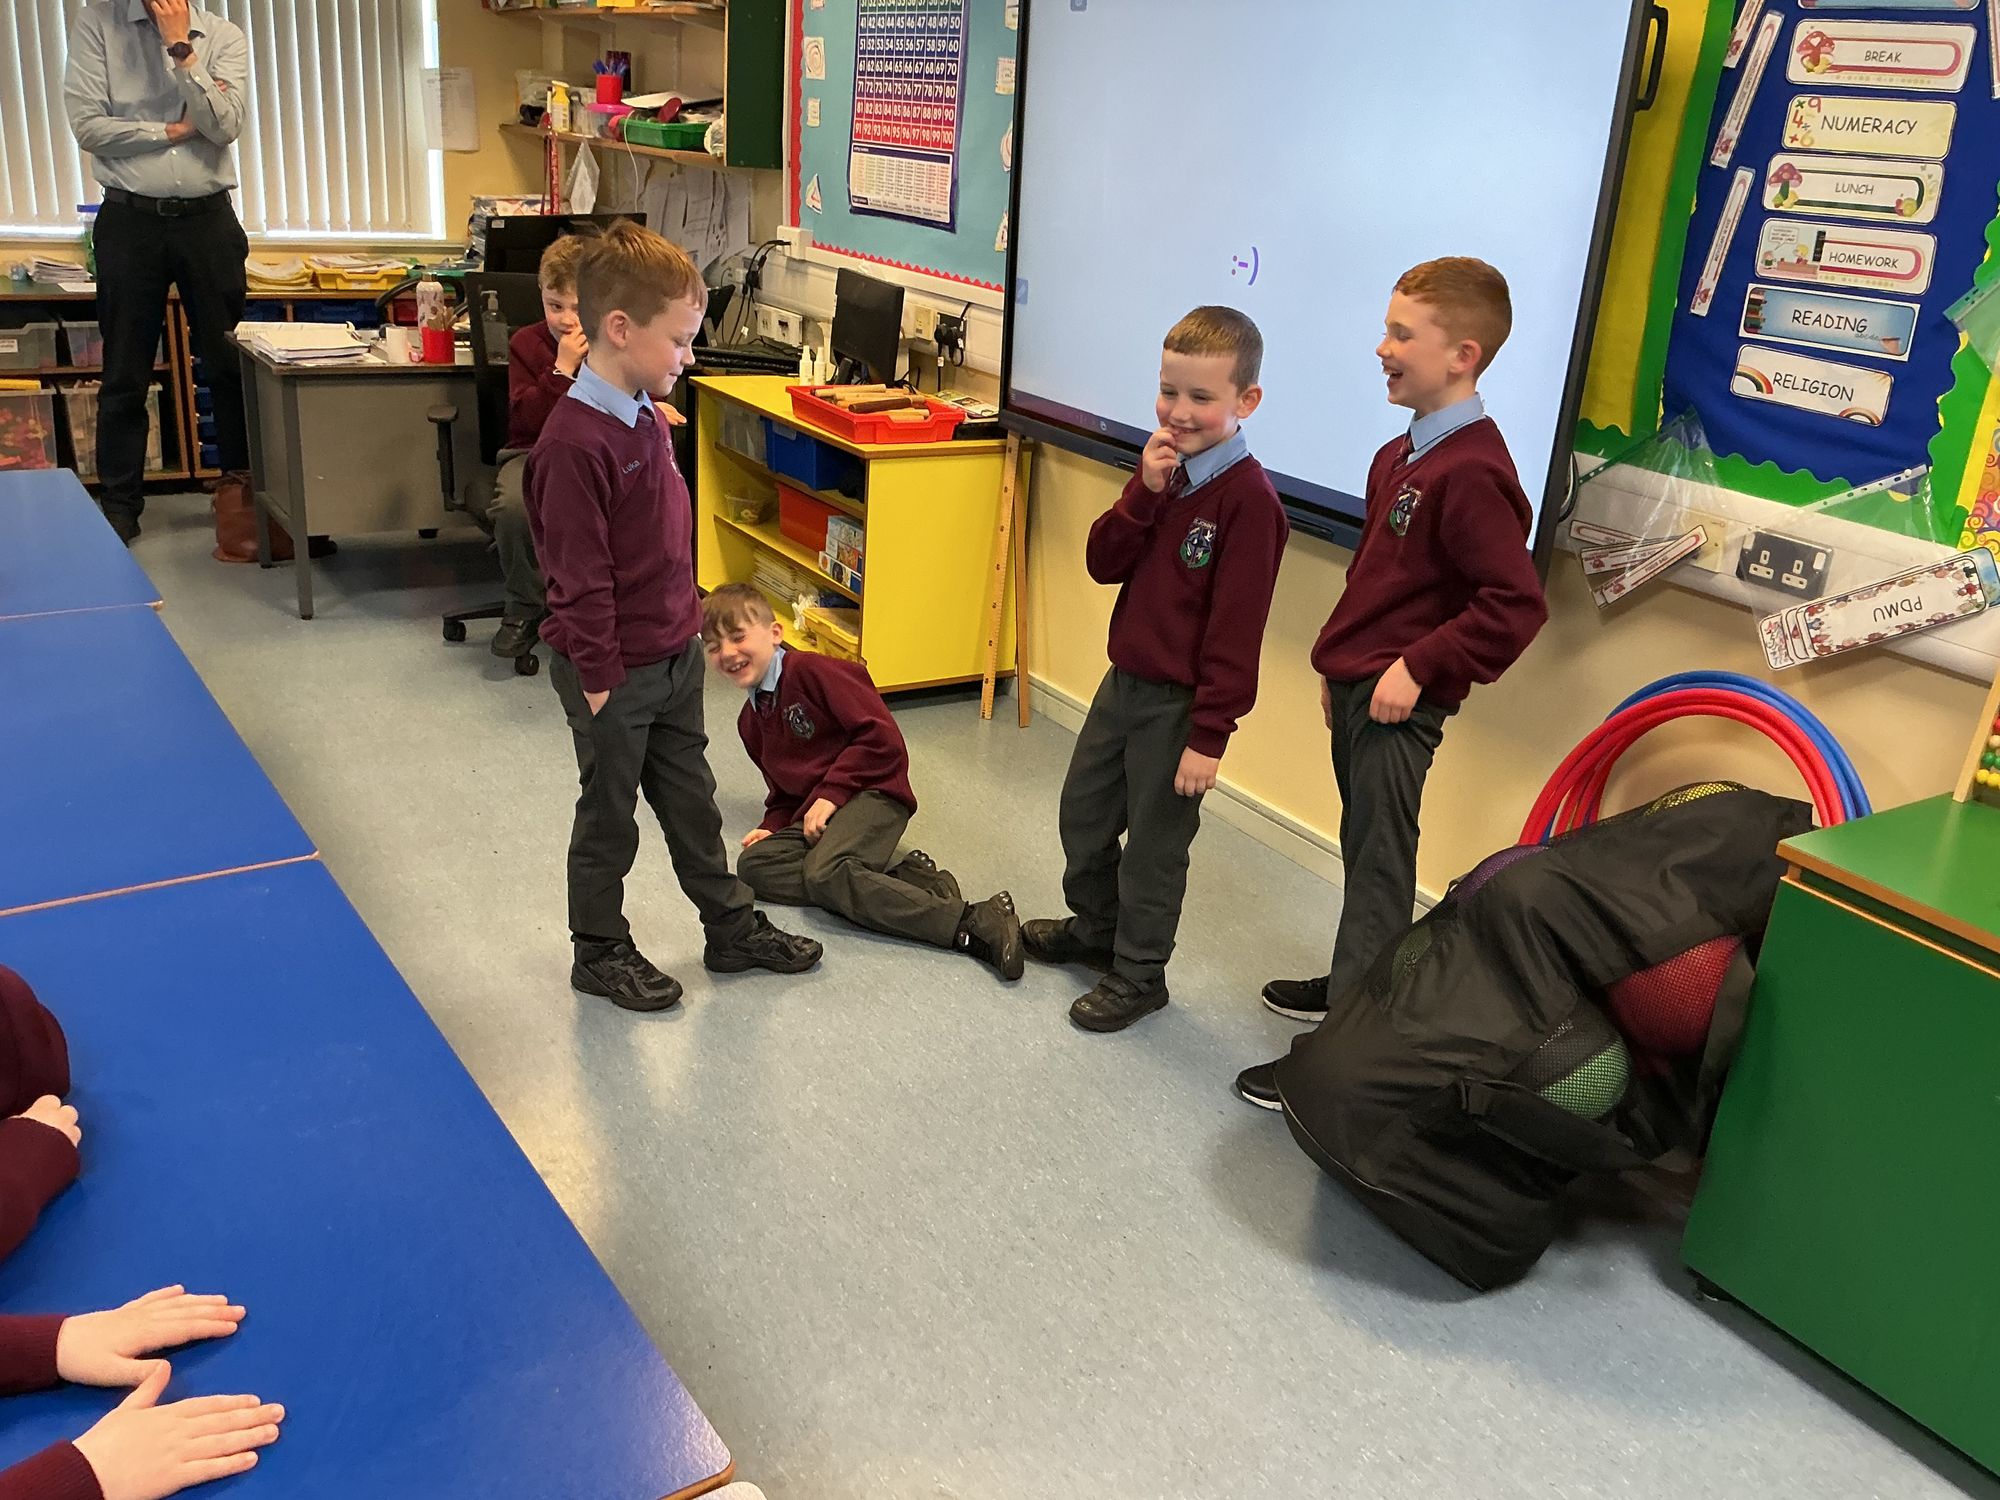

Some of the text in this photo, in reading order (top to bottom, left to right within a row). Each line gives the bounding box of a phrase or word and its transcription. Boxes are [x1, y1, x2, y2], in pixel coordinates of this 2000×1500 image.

[860, 16, 960, 29] 41 42 43 44 45 46 47 48 49 50
[860, 39, 959, 52] 51 52 53 54 55 56 57 58 59 60
[1864, 50, 1902, 63] BREAK
[859, 60, 957, 76] 61 62 63 64 65 66 67 68 69 70
[858, 81, 956, 98] 71 72 73 74 75 76 77 78 79 80
[857, 102, 954, 121] 81 82 83 84 85 86 87 88 89 90
[855, 123, 953, 144] 91 92 93 94 95 96 97 98 99 100
[1821, 115, 1917, 135] NUMERACY
[1835, 183, 1874, 195] LUNCH
[1829, 252, 1899, 269] HOMEWORK
[1792, 309, 1867, 333] READING
[1773, 372, 1854, 401] RELIGION
[621, 460, 640, 474] Luka
[1873, 596, 1923, 622] PDMU
